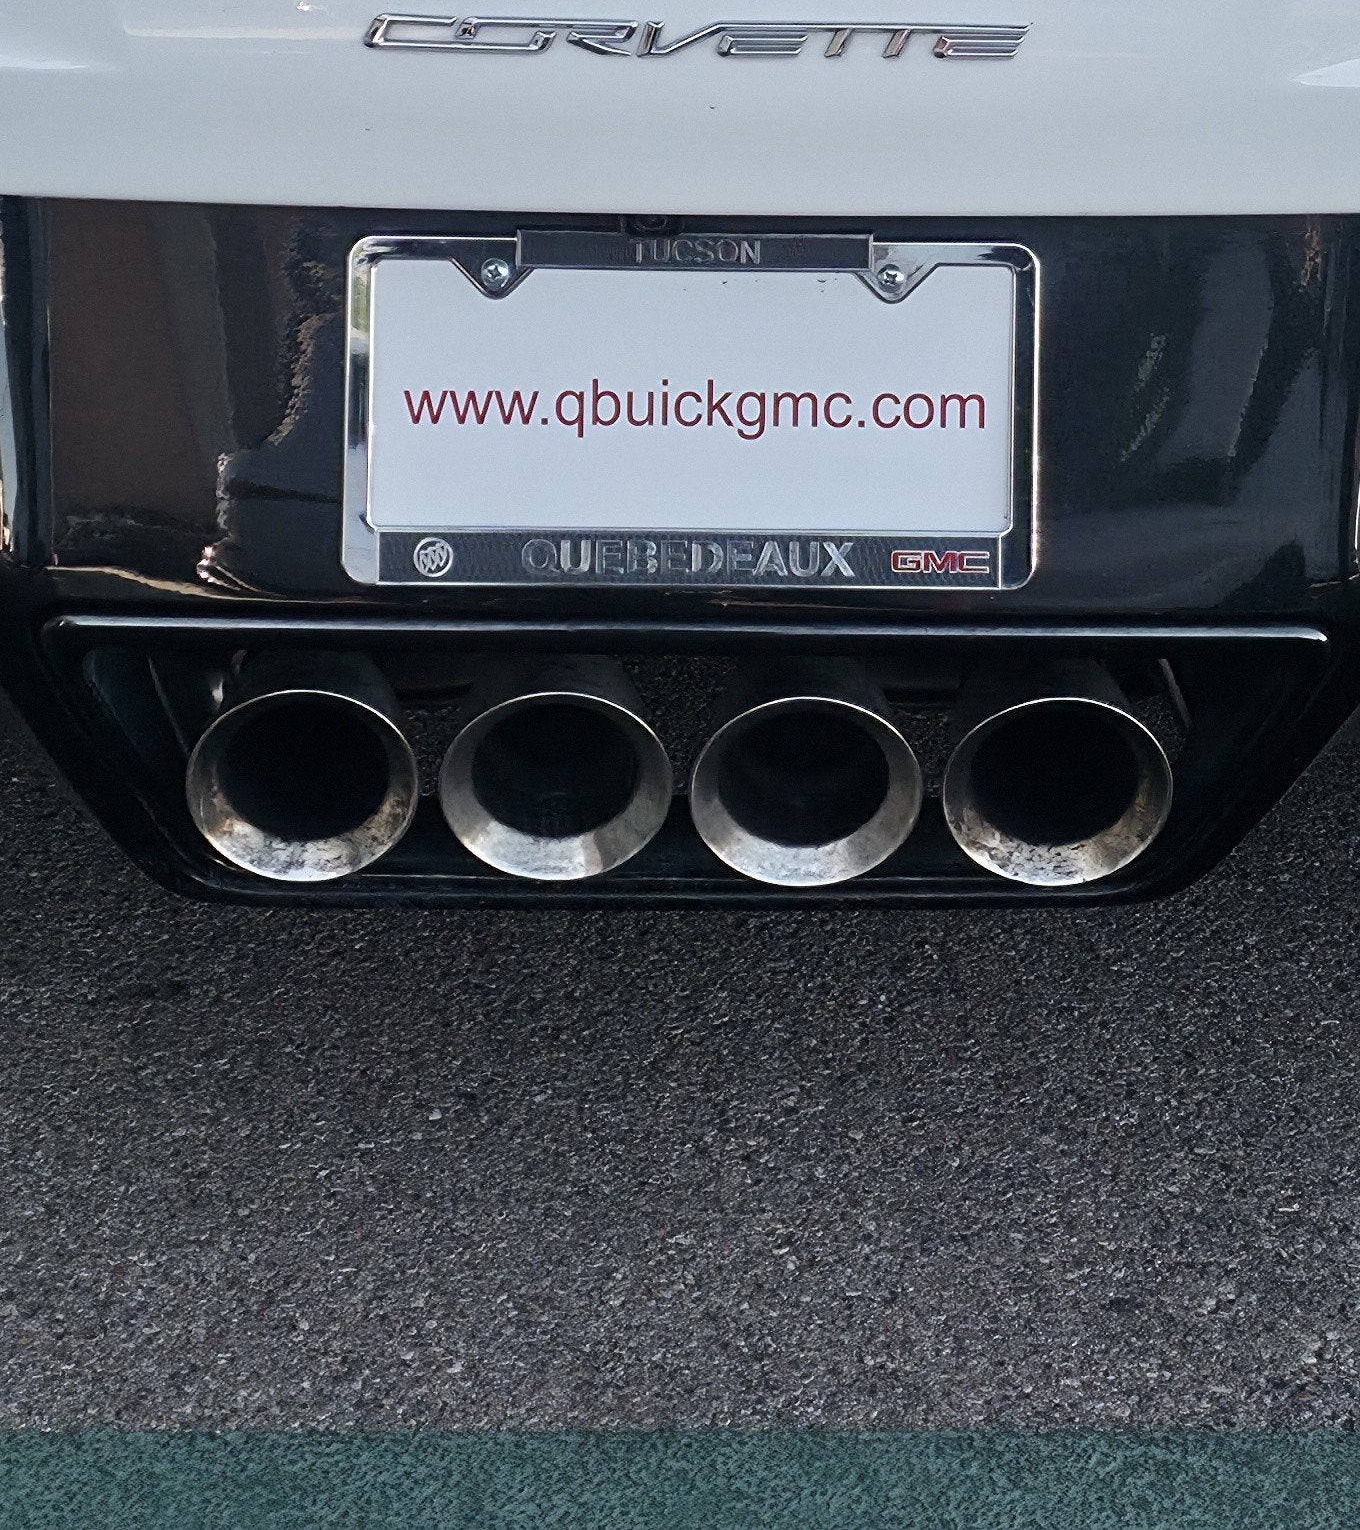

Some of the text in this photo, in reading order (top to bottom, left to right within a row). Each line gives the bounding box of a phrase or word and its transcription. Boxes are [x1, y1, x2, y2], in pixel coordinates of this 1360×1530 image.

[363, 13, 1033, 59] CORVETTE
[629, 237, 762, 265] TUCSON
[404, 379, 986, 440] www.qbuickgmc.com
[520, 537, 856, 578] QUEBEDEAUX
[890, 549, 990, 575] GMC
